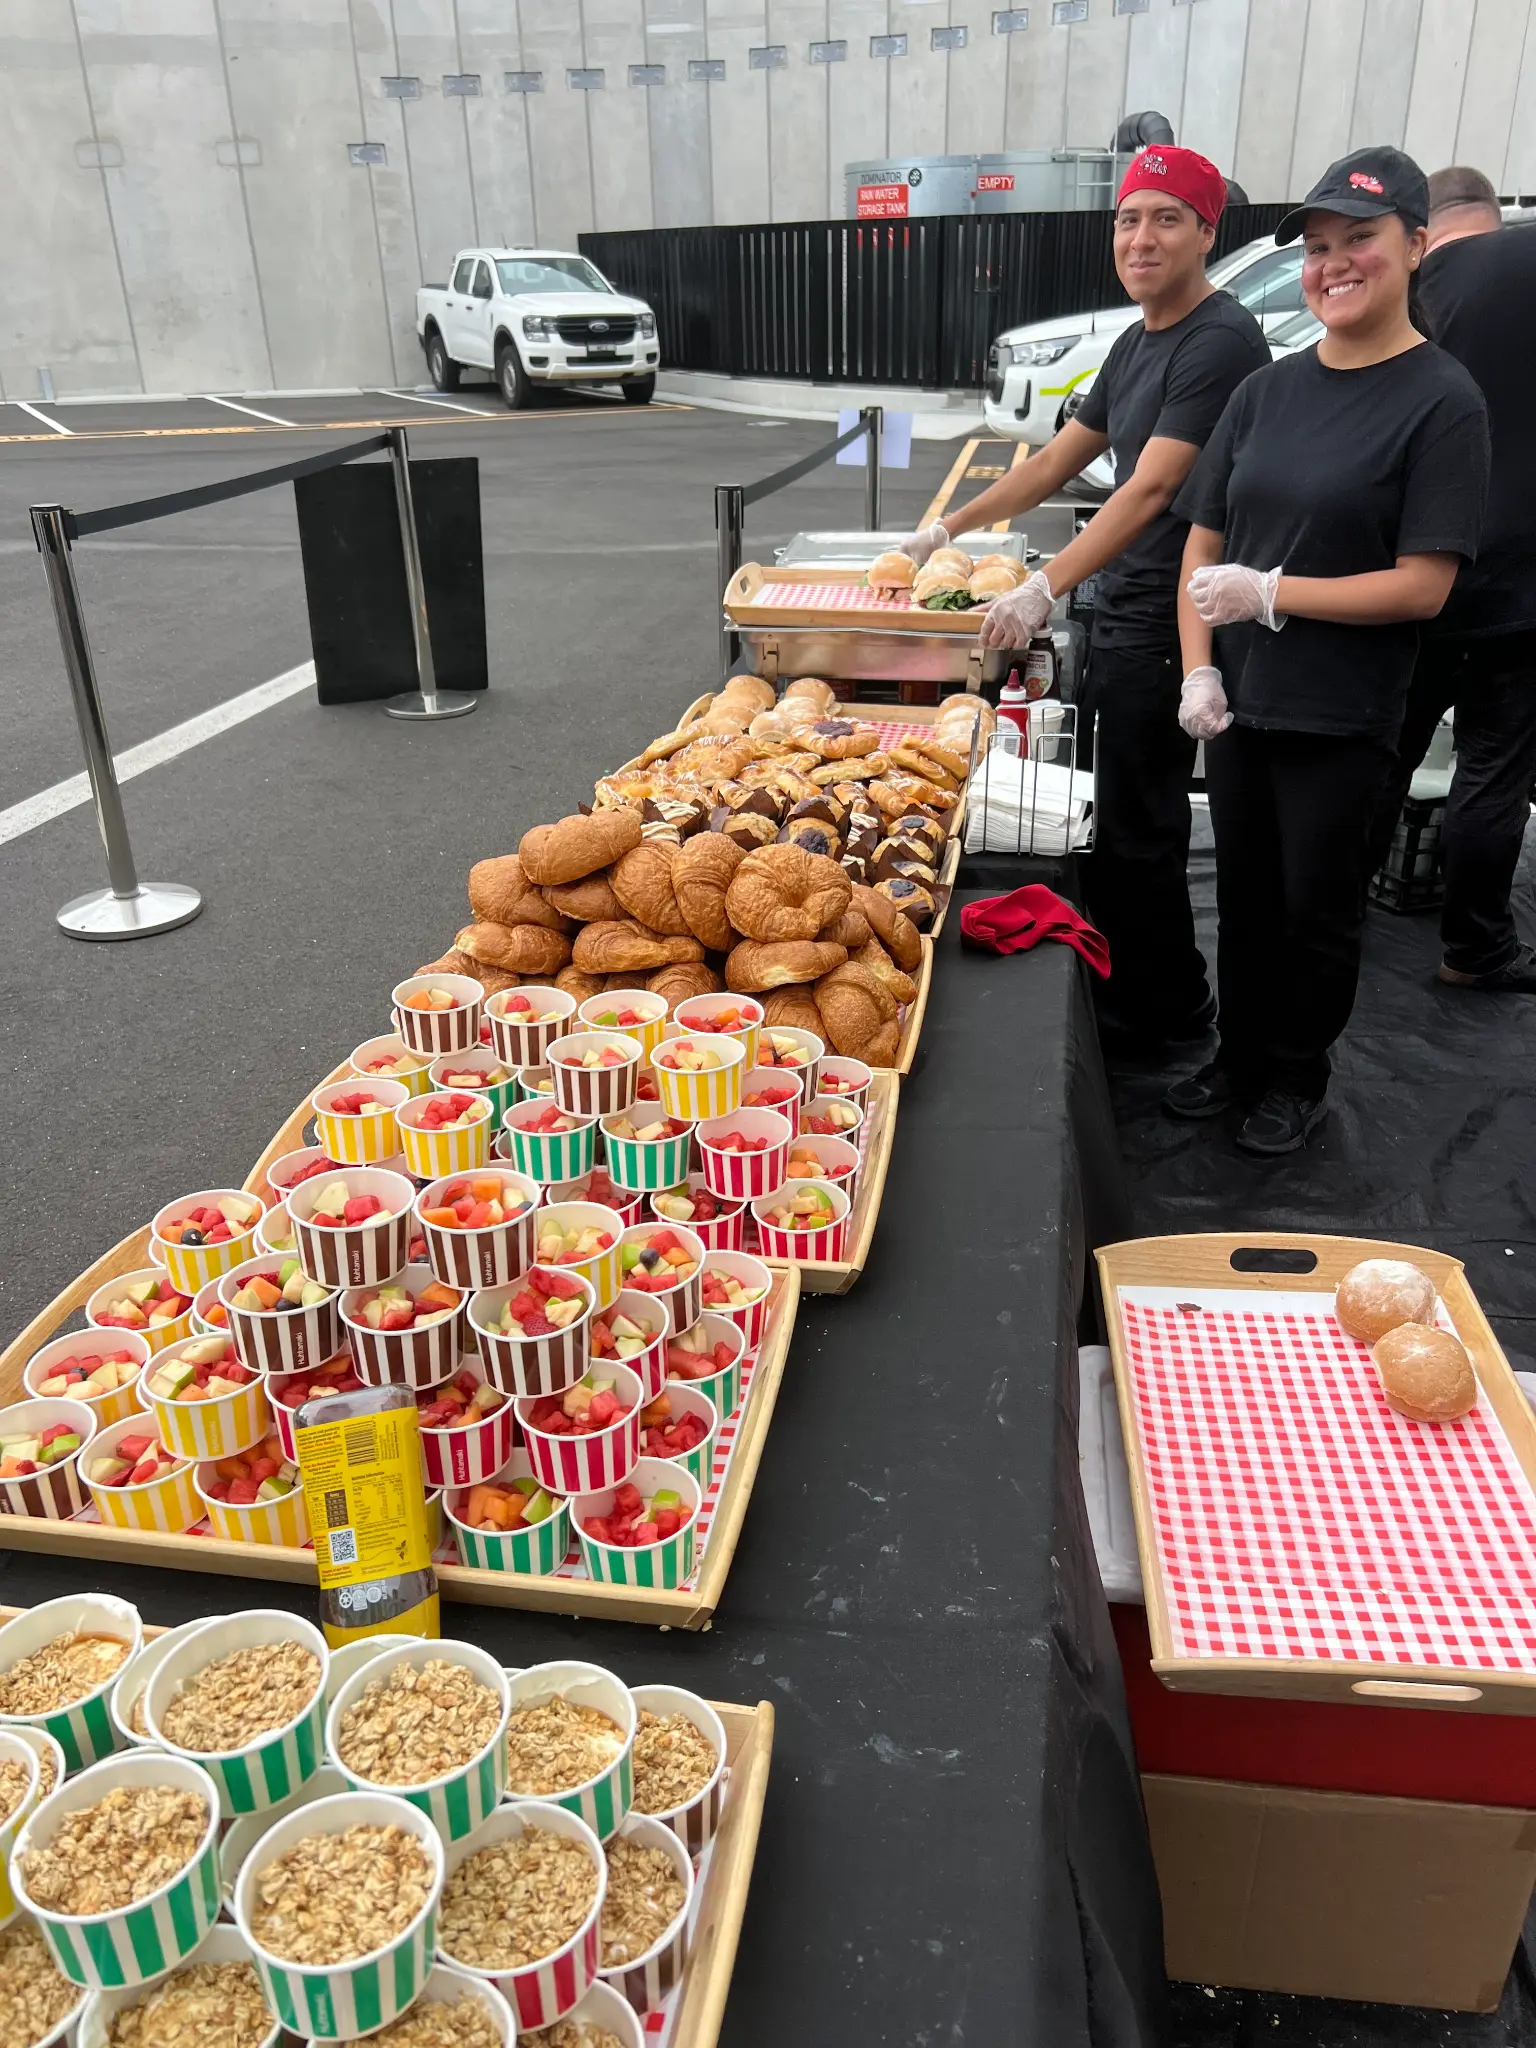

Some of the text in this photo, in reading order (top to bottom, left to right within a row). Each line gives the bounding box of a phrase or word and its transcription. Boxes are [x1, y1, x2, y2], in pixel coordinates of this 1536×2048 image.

[861, 172, 902, 185] DOMINATOR
[978, 176, 1014, 190] EMPTY
[860, 187, 900, 201] RAIN WATER
[857, 202, 907, 216] STORAGE TANK
